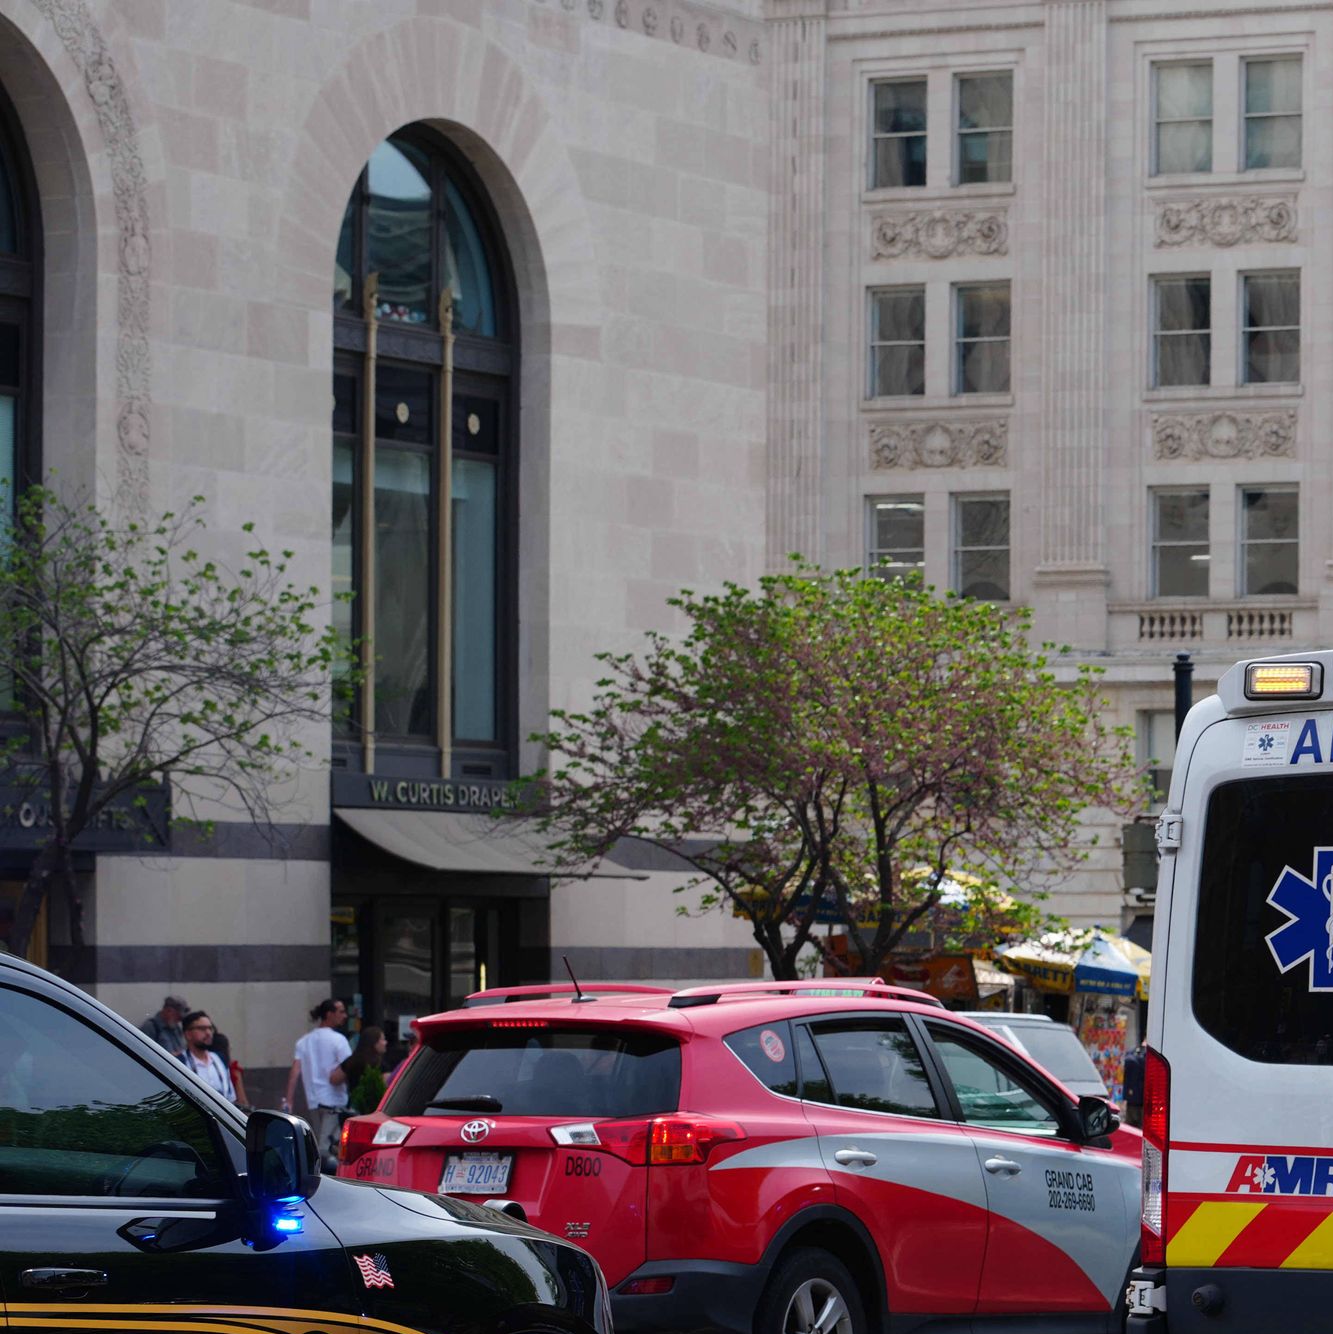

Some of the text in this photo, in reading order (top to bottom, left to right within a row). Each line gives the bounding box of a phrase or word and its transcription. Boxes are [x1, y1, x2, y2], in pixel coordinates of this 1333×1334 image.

[1260, 722, 1290, 730] HEALTH
[372, 780, 393, 801] W.
[396, 782, 454, 804] CURTIS
[356, 1157, 395, 1178] GRAND
[444, 1165, 508, 1184] H 92043
[564, 1156, 602, 1177] D800
[1045, 1169, 1093, 1192] GRAND CAB
